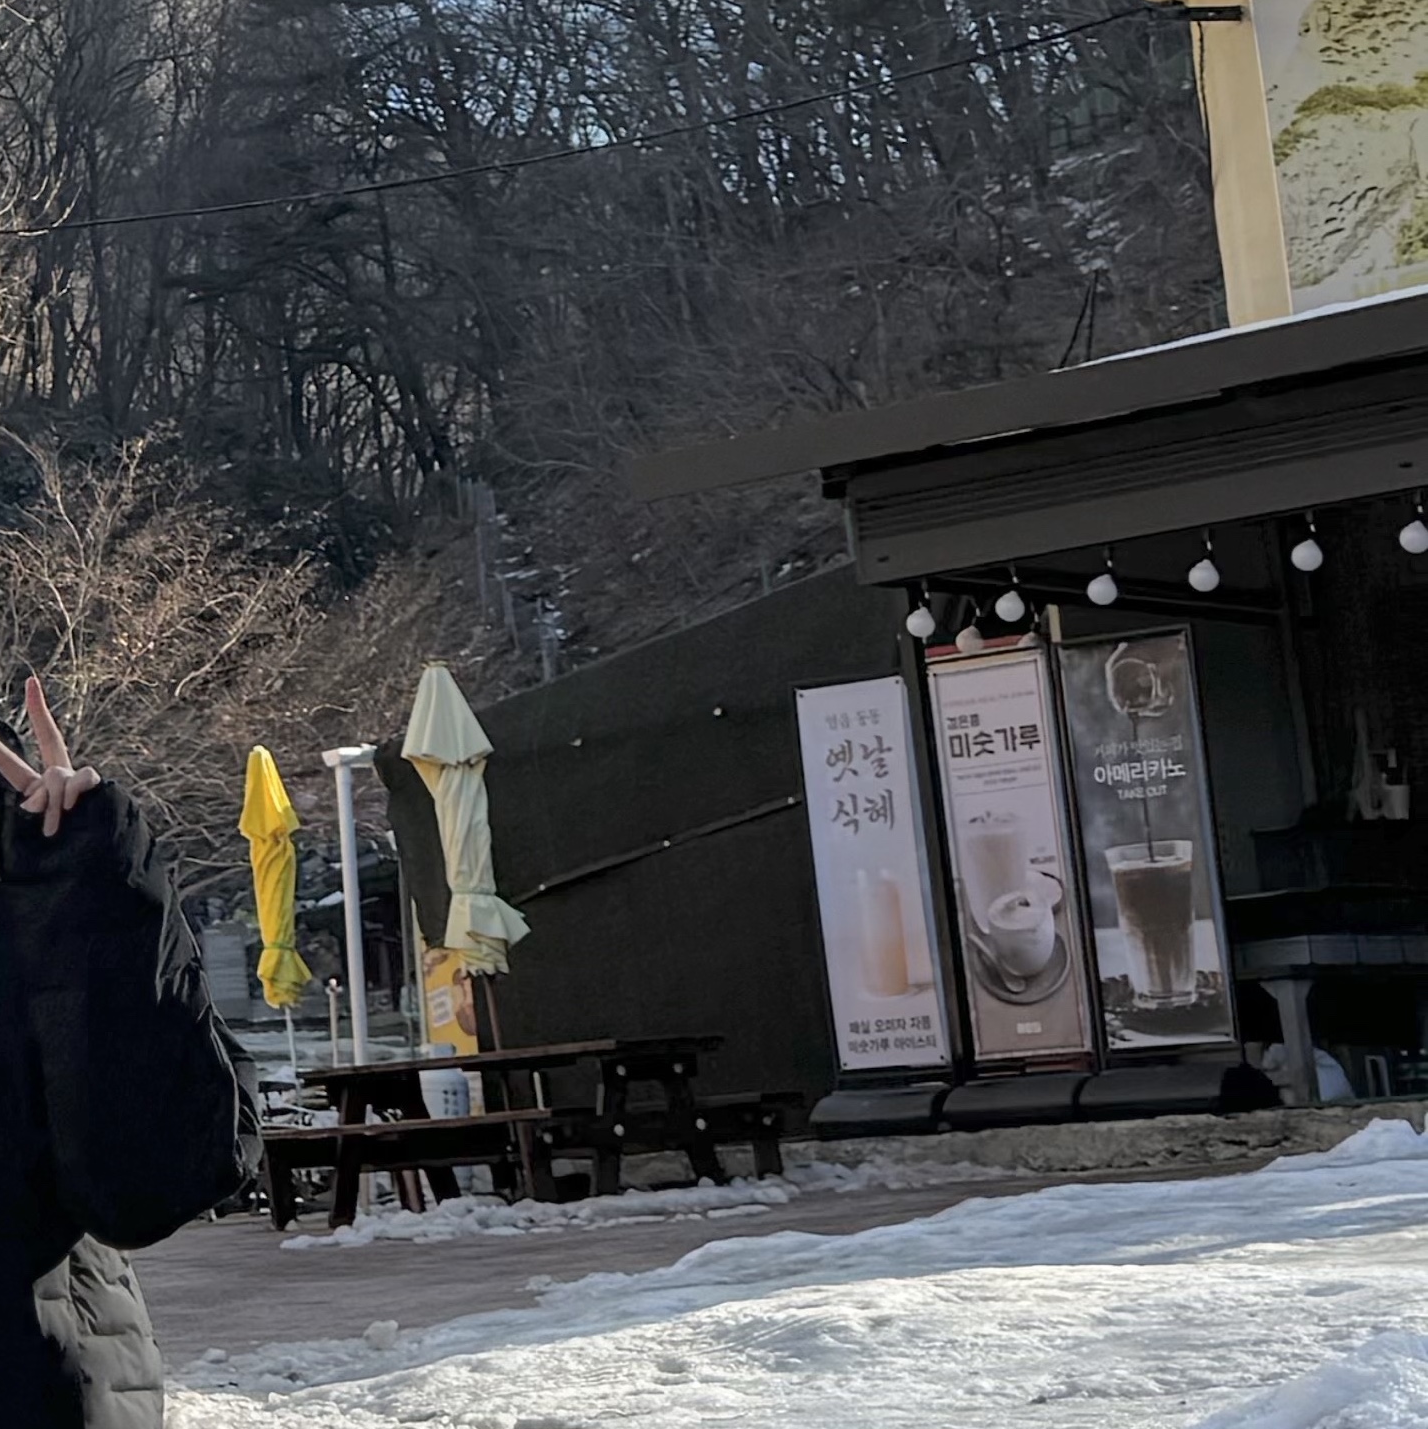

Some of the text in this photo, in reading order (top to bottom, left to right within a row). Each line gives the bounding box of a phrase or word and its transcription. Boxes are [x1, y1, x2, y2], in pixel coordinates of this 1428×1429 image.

[825, 734, 894, 783] 옛날
[948, 723, 1042, 759] 미숫가루
[1093, 757, 1187, 786] 아메리카노
[1117, 784, 1169, 800] TAKE OUT
[831, 788, 896, 836] 식혜
